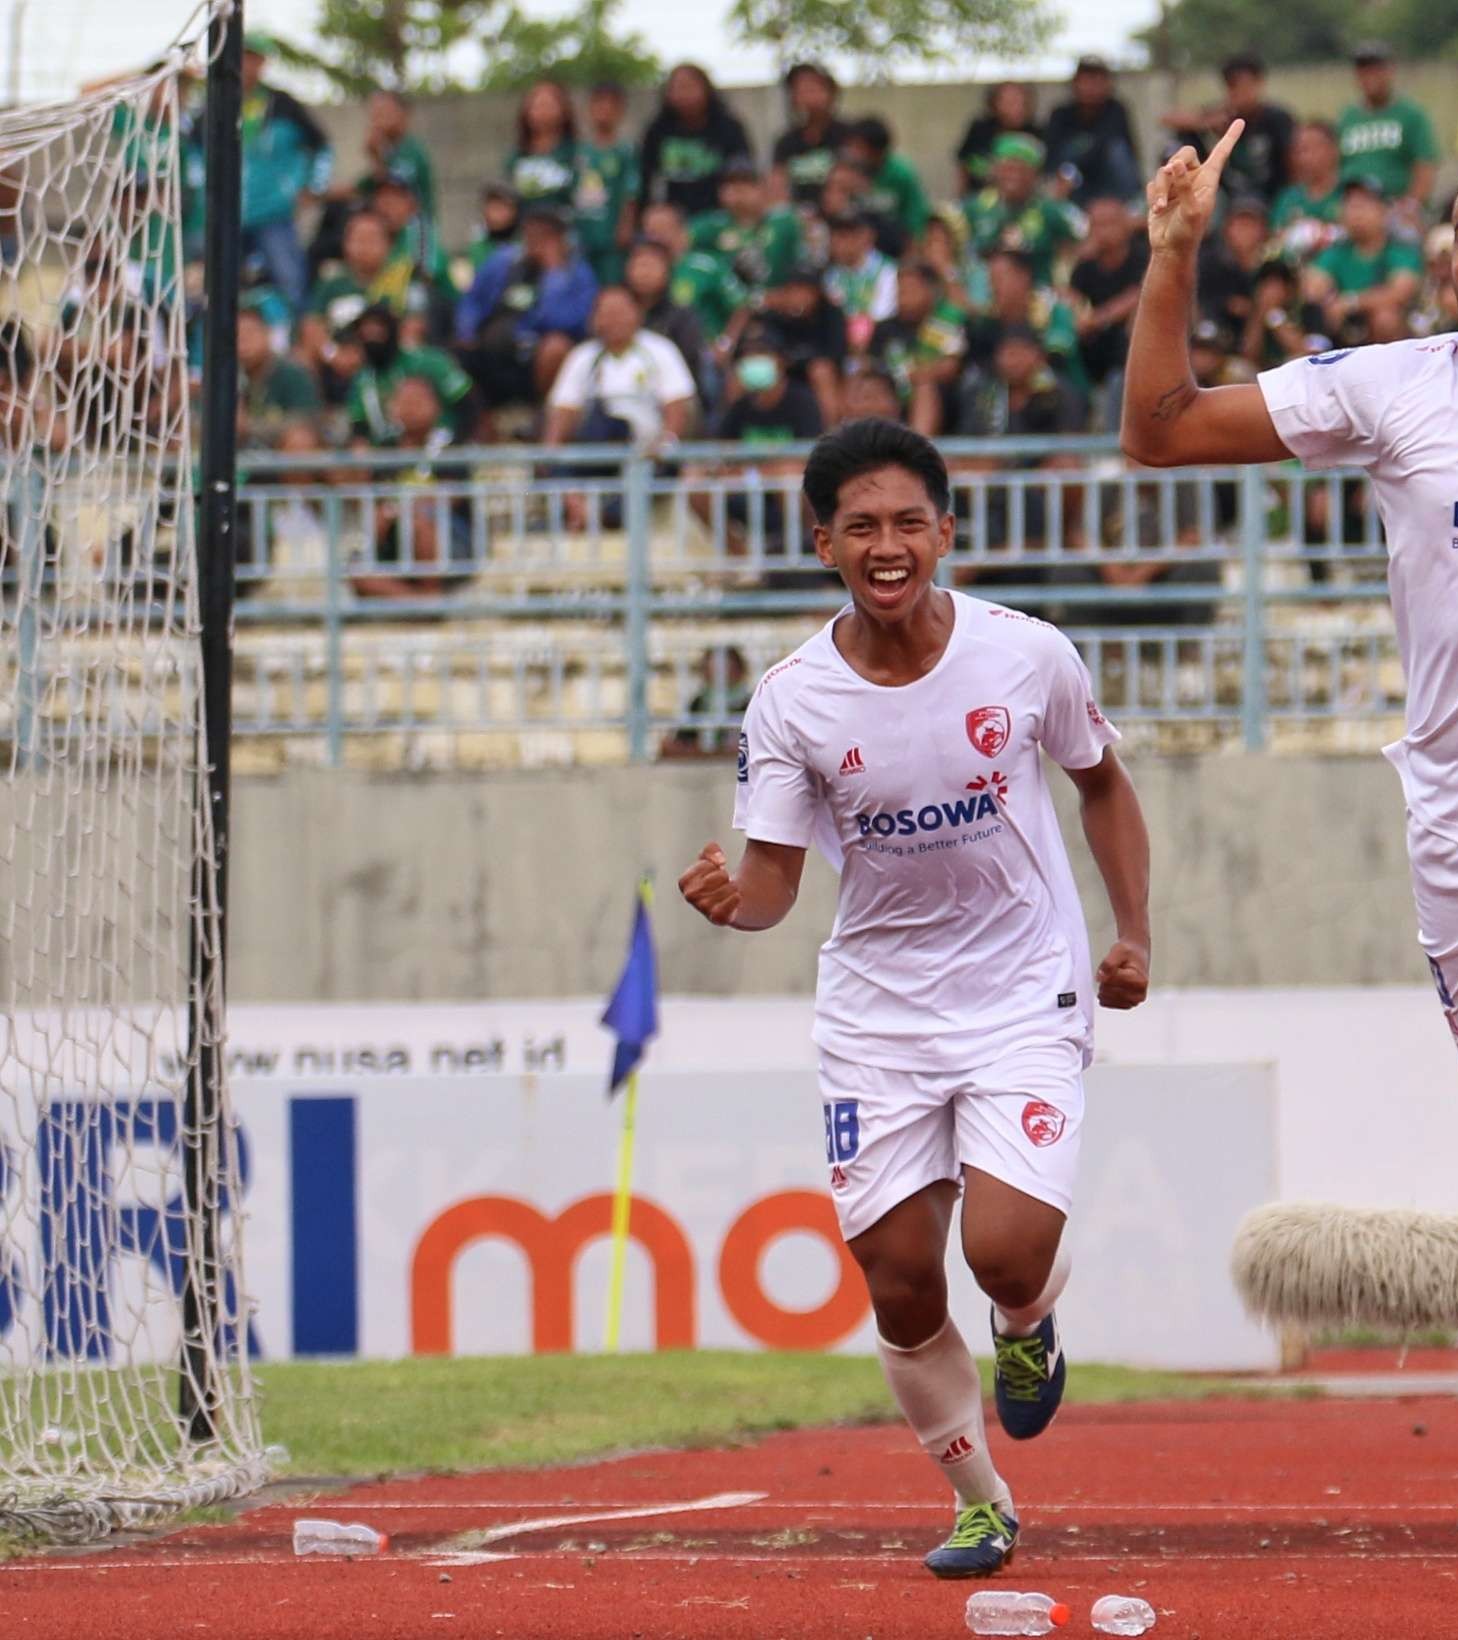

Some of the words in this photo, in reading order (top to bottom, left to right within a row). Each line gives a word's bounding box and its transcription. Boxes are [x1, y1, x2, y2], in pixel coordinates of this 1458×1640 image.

[856, 793, 998, 837] BOSOWA
[863, 839, 903, 857] uilding
[907, 846, 915, 855] a
[918, 837, 958, 852] Better
[961, 824, 1002, 844] Future
